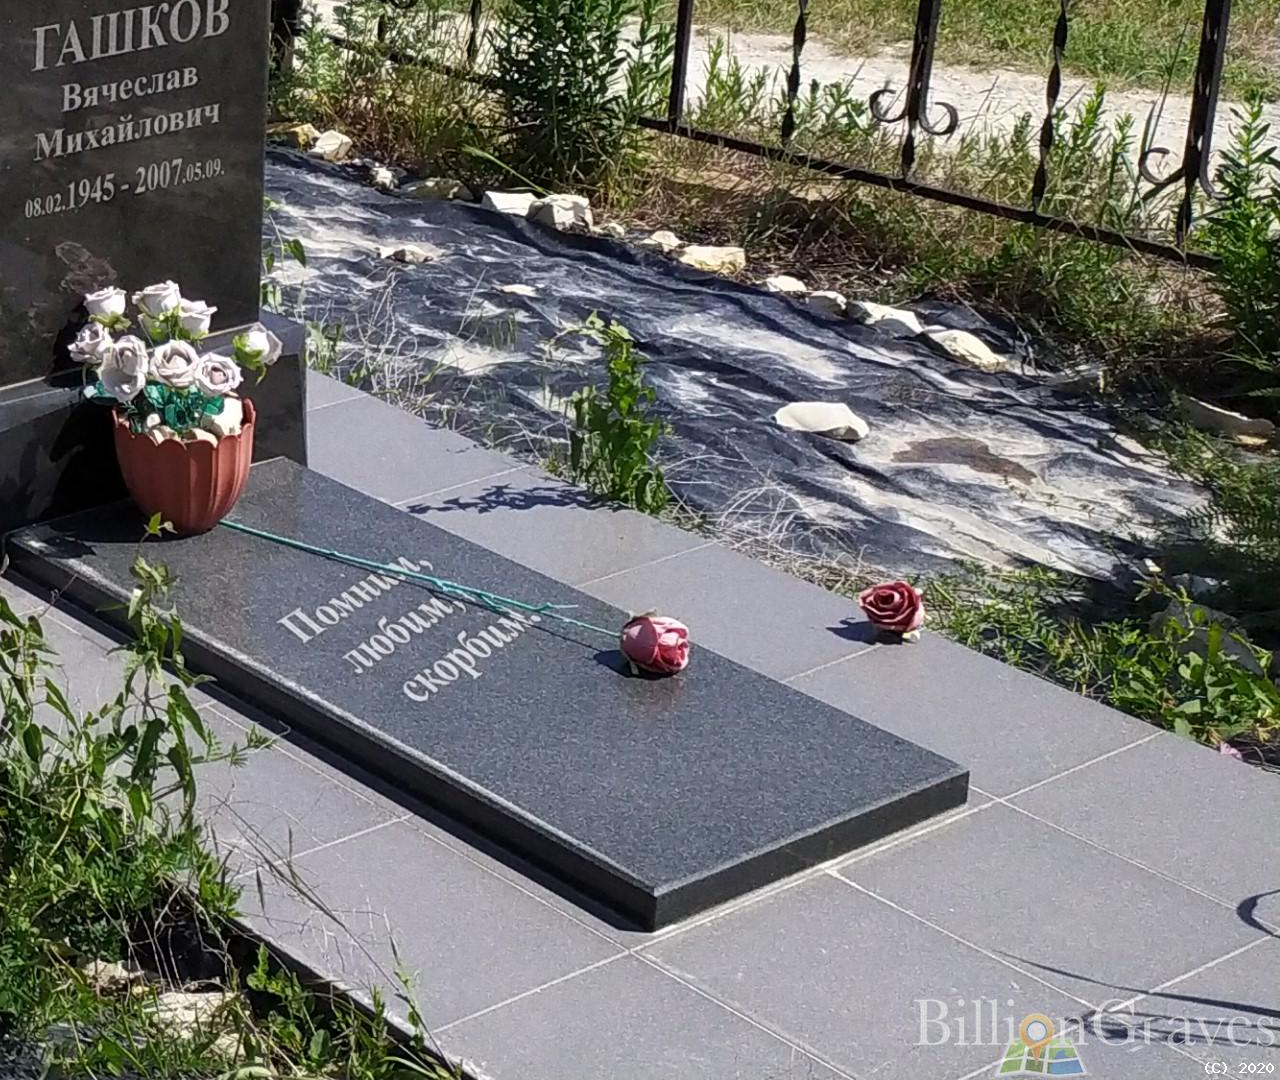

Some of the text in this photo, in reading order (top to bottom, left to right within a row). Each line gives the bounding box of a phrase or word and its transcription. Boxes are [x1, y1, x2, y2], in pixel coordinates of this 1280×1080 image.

[61, 67, 198, 112] Вячеслав
[33, 103, 221, 161] Михайлович
[25, 173, 115, 218] 08.02.1945
[134, 158, 225, 194] 2007.05.09.
[277, 556, 434, 644] Помним,
[342, 596, 467, 674] любим,
[402, 611, 542, 702] скорбим.
